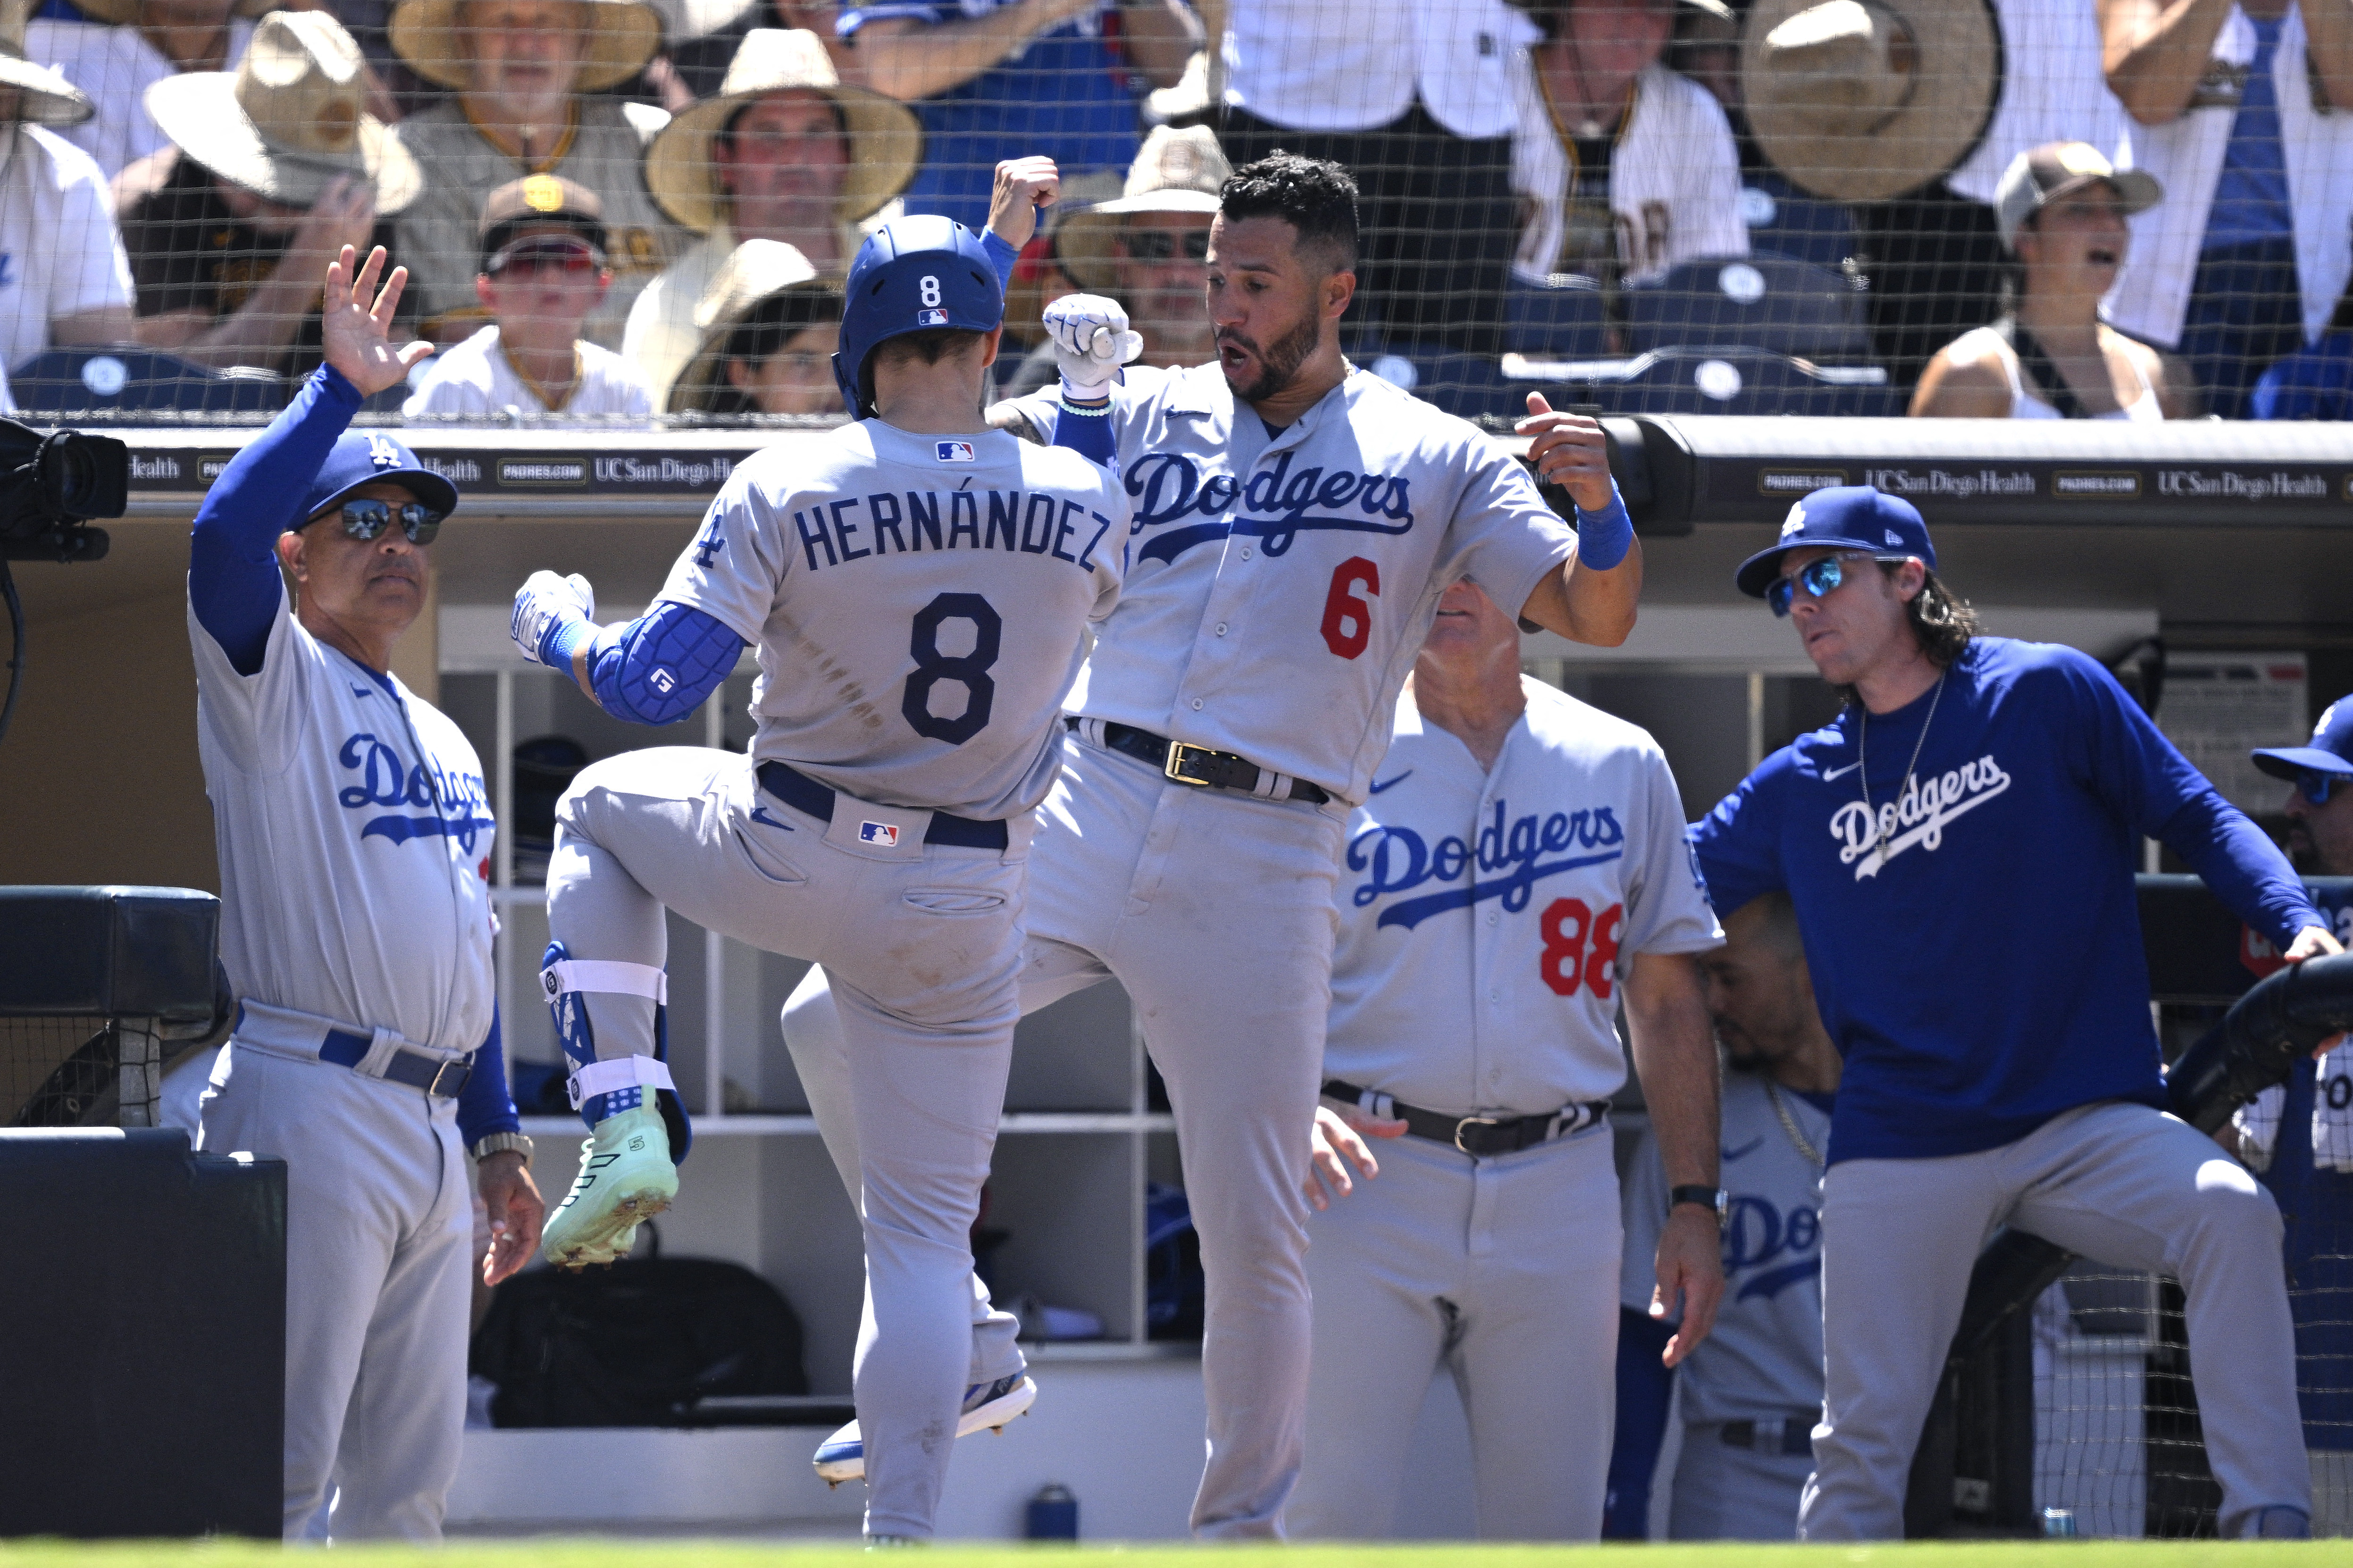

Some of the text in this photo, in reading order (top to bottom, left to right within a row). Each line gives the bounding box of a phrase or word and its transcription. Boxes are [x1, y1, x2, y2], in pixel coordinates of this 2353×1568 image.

[920, 275, 941, 307] 8
[362, 429, 402, 467] LA
[595, 458, 625, 481] UC
[625, 457, 661, 481] San
[661, 458, 713, 486] Diego
[794, 476, 1110, 573] HERNÁNDEZ
[1122, 451, 1414, 558] Dodgers
[1320, 556, 1380, 660] 6
[901, 592, 1002, 745] 8
[1347, 800, 1624, 913] Dodgers
[1829, 755, 2010, 863] Dodgers
[1541, 898, 1623, 999] 88
